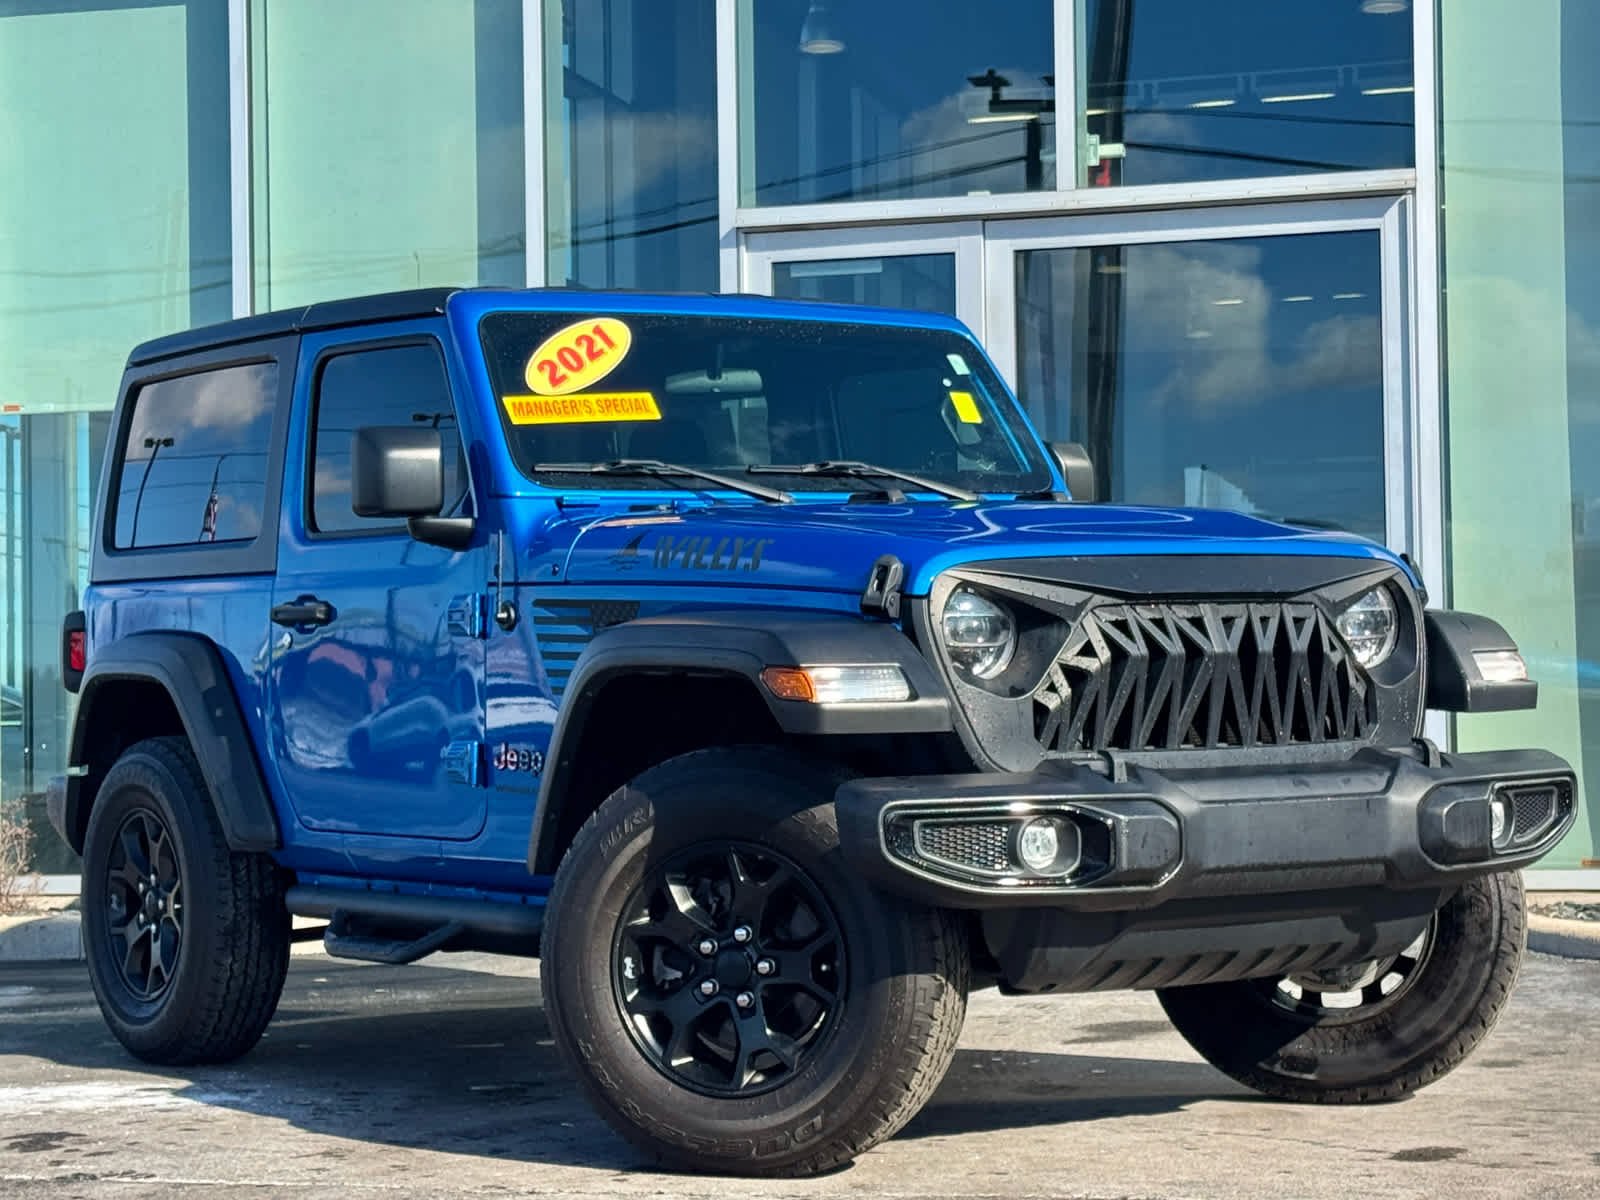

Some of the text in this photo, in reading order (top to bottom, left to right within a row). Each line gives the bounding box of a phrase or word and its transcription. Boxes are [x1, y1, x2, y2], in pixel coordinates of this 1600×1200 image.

[537, 324, 618, 388] 2021
[511, 398, 651, 417] MANAGER'S SPECIAL
[653, 535, 776, 573] WILLYS
[493, 742, 543, 777] Jeep
